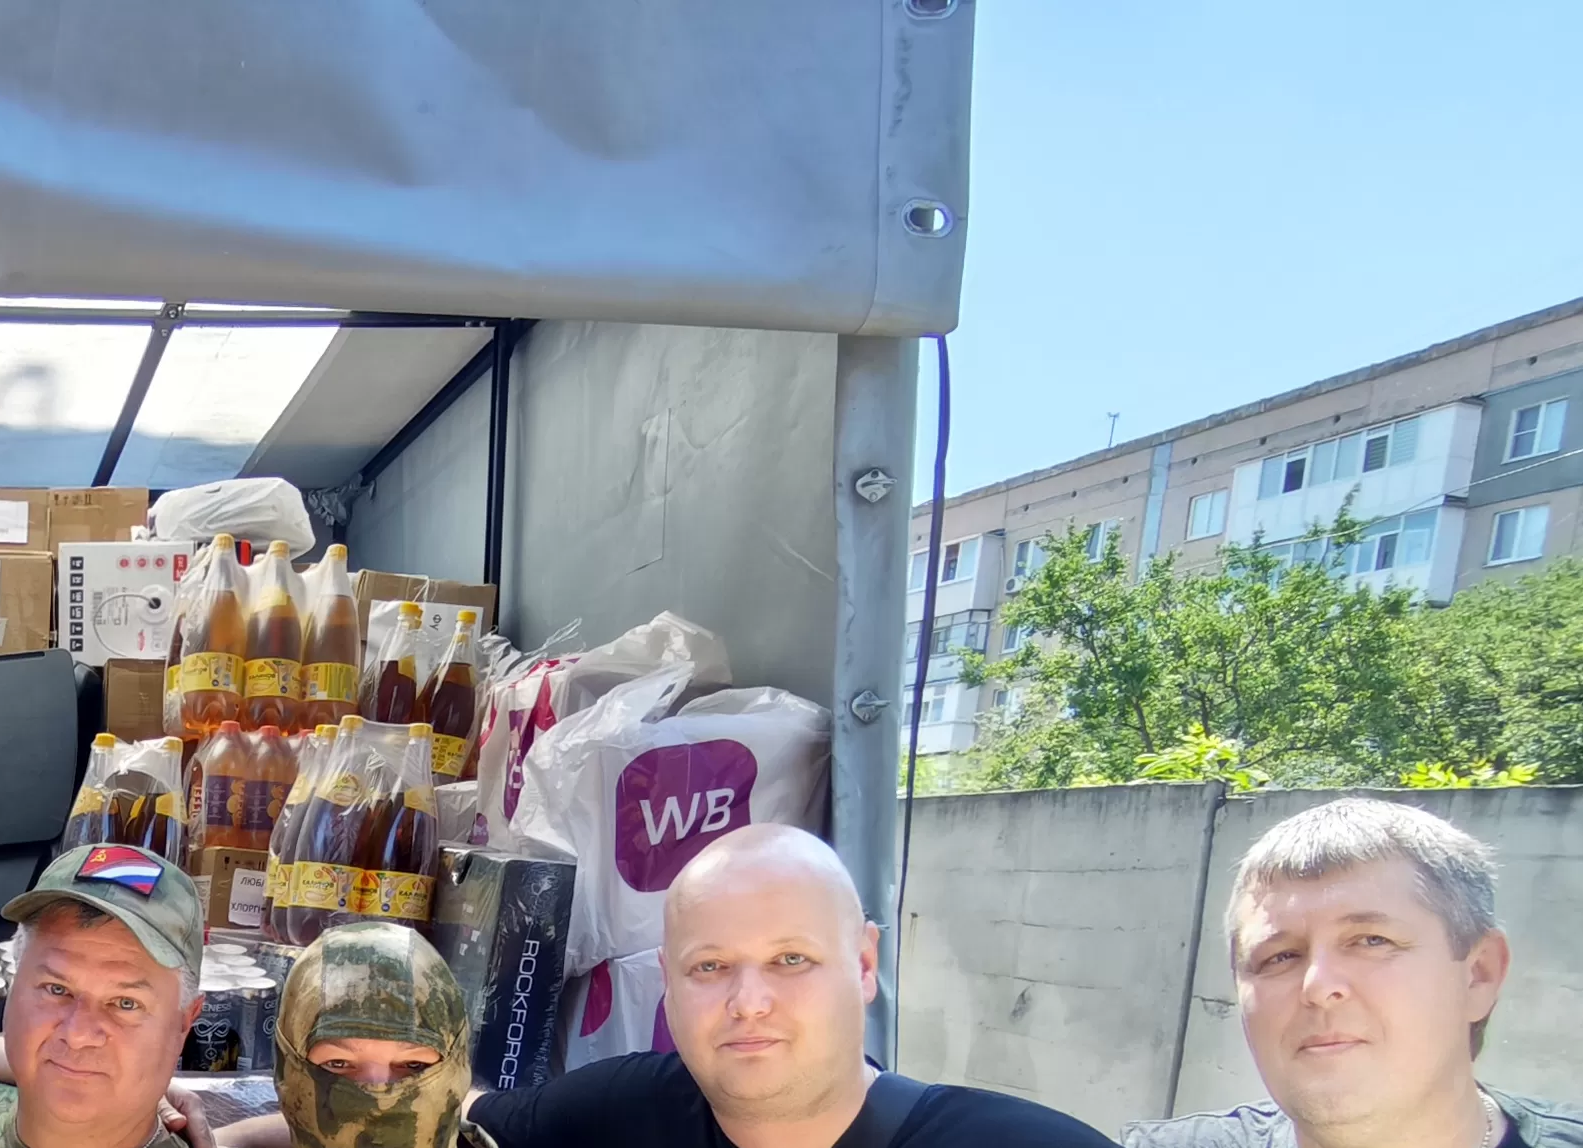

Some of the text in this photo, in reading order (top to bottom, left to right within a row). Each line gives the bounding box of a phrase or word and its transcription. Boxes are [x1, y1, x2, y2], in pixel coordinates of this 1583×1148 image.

[638, 787, 736, 846] WB
[231, 902, 261, 913] ХЛОРГ
[498, 939, 540, 1089] ROCKFORCE
